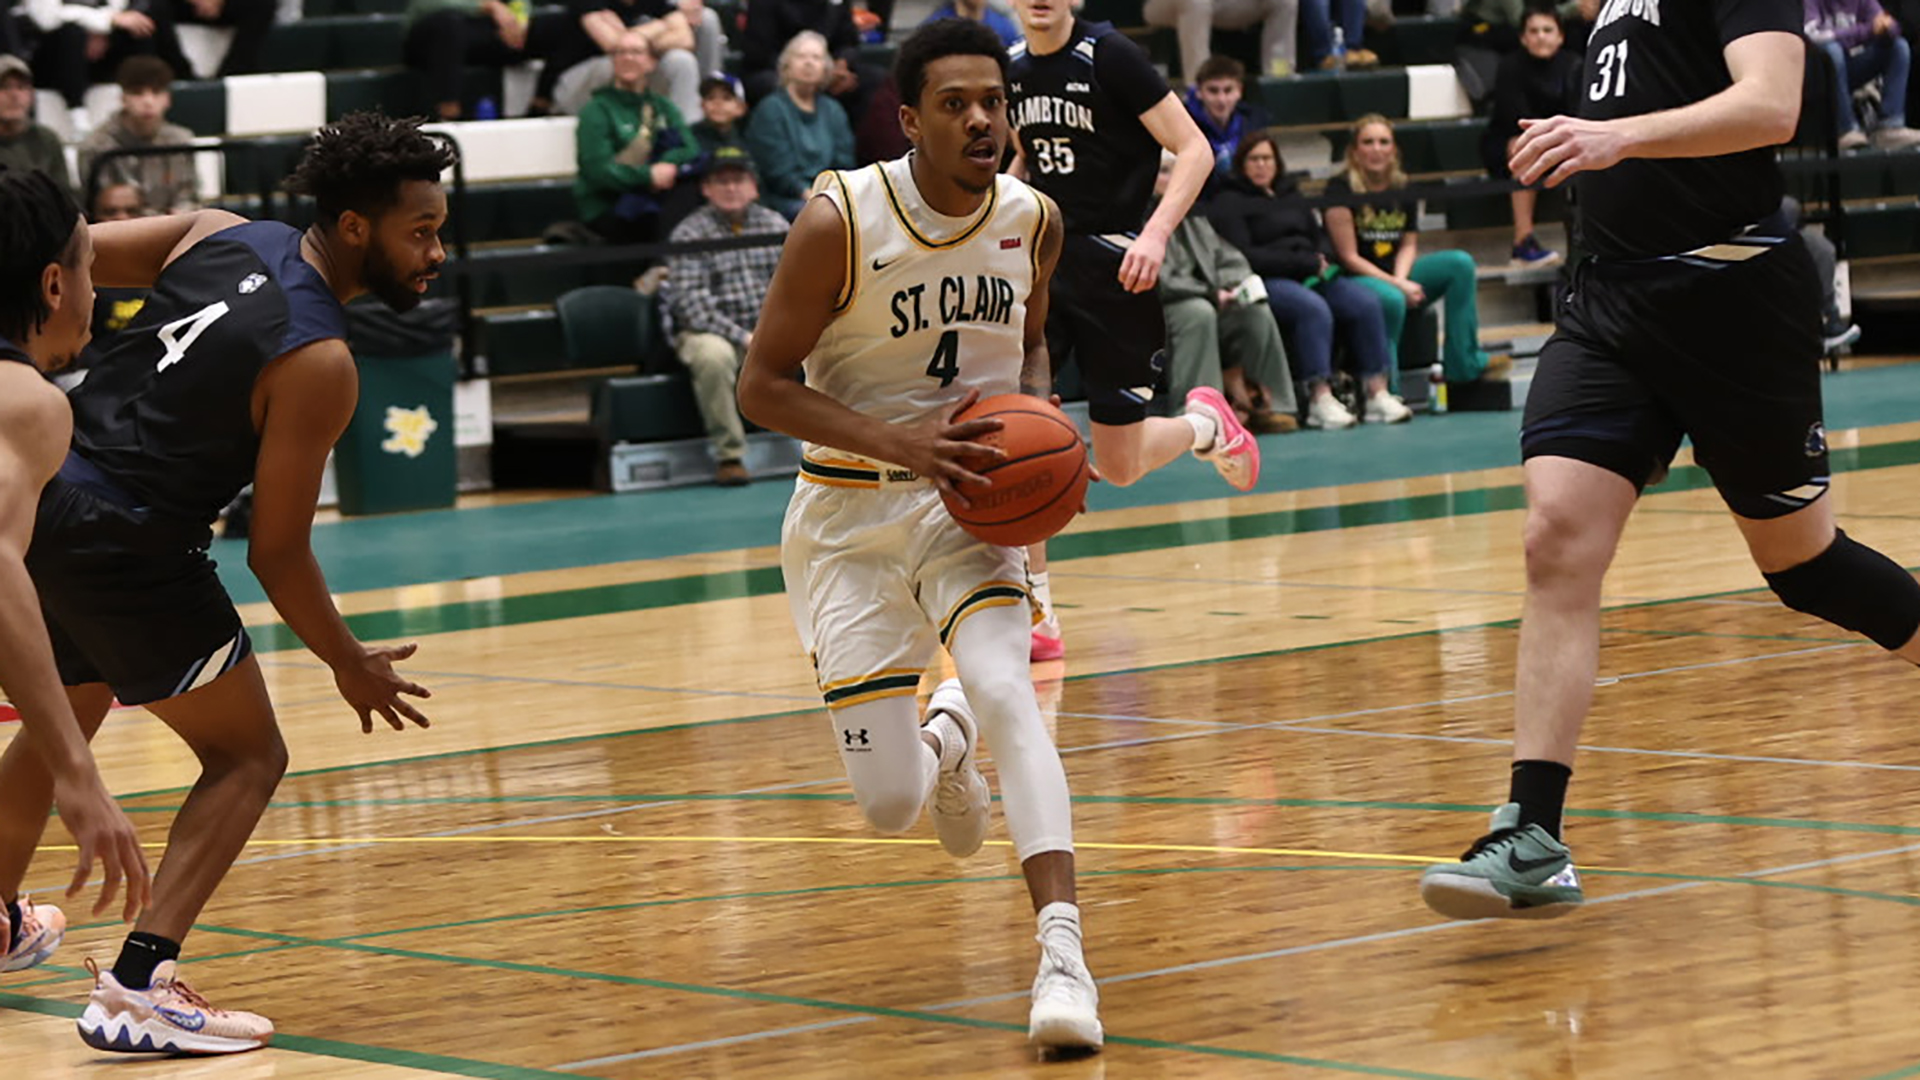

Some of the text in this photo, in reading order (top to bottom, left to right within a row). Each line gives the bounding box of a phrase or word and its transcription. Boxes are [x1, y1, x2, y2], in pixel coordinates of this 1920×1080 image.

[1589, 38, 1628, 102] 31
[1032, 137, 1075, 174] 35
[156, 300, 230, 373] 4
[890, 275, 1014, 338] ST. CLAIR
[926, 330, 959, 388] 4
